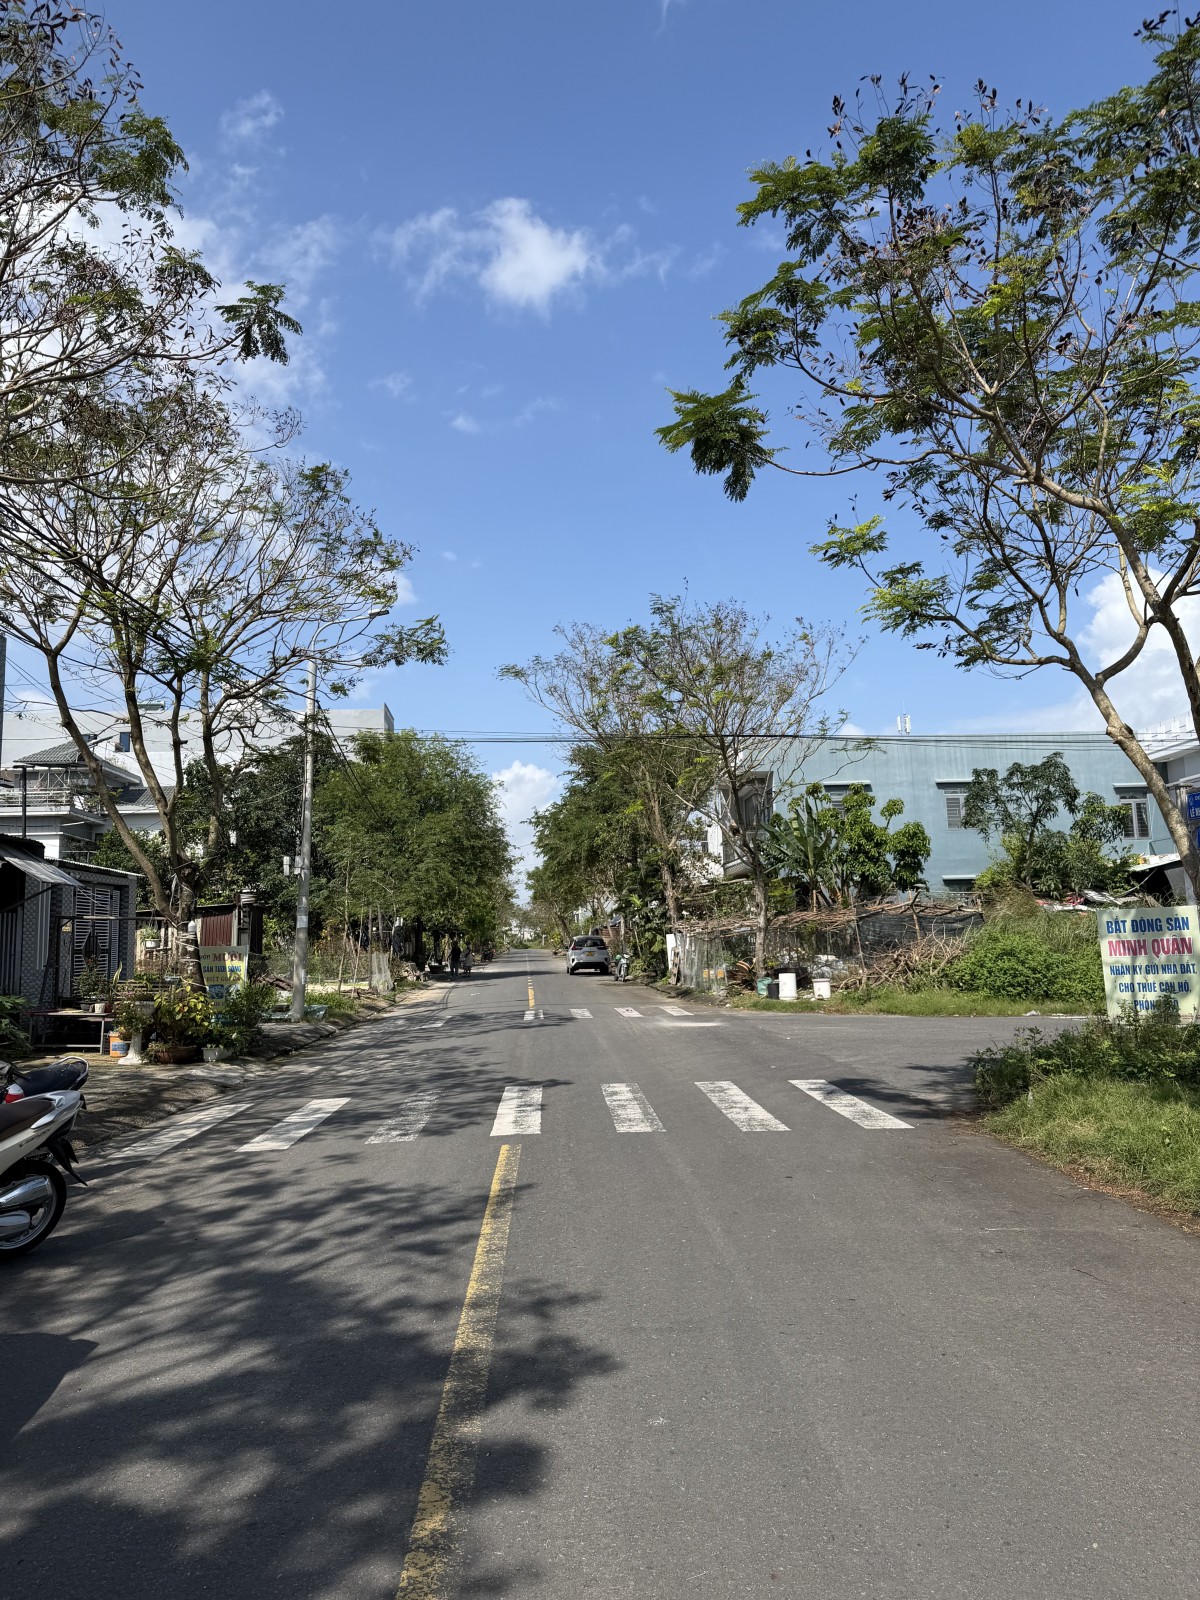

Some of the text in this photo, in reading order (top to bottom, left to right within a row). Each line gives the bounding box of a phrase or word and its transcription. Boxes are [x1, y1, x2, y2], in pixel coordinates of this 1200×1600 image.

[1106, 914, 1189, 935] BẤT ĐỘNG SẢN
[1108, 935, 1193, 958] MINH QUÂN
[1110, 963, 1130, 977] NHẬN
[1132, 963, 1142, 975] KÝ
[1145, 962, 1159, 975] GỬI
[1161, 962, 1178, 974] NHÀ
[1119, 982, 1135, 993] CHO
[1137, 981, 1157, 992] THUÊ
[1134, 998, 1160, 1010] PHÒN
